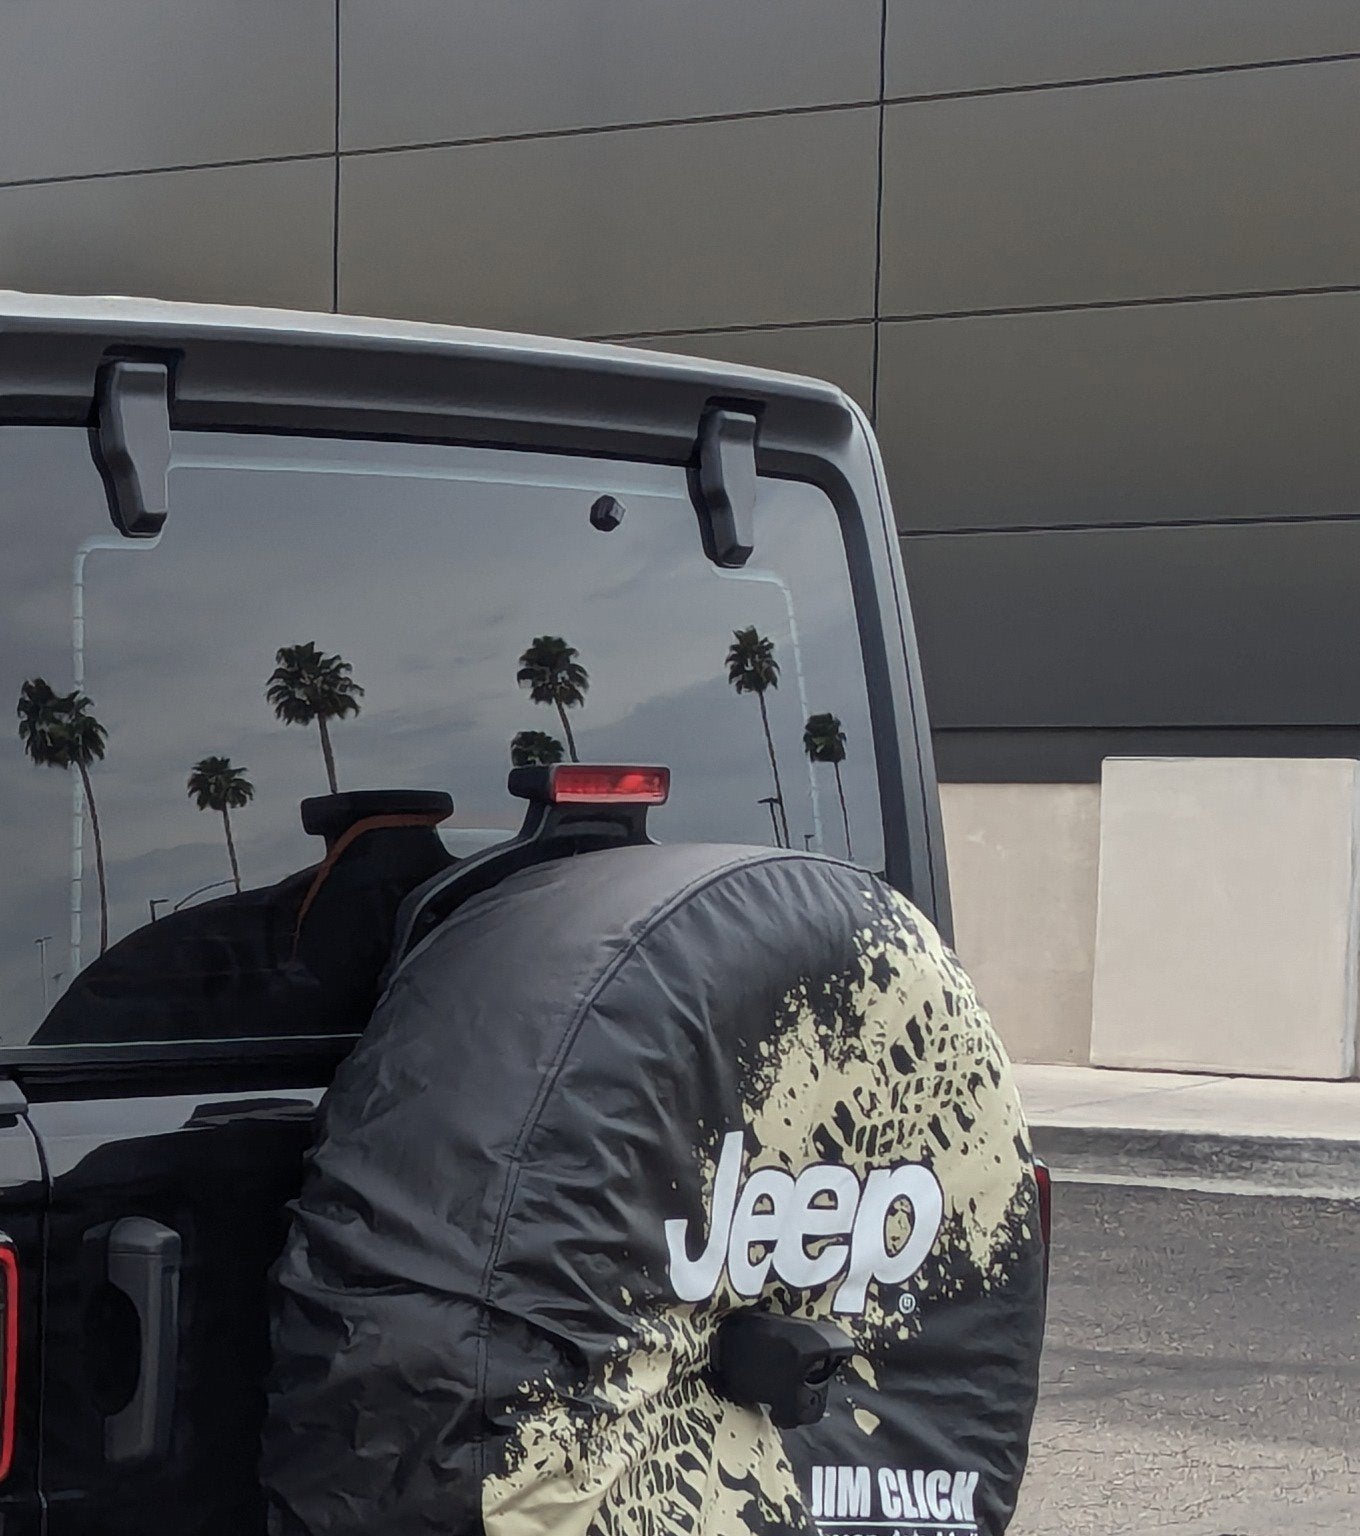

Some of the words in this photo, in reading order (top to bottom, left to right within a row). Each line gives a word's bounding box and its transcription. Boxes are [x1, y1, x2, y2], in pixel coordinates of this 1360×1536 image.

[664, 1130, 944, 1314] Jeep
[812, 1465, 871, 1518] JIM
[877, 1467, 980, 1522] CLICK
